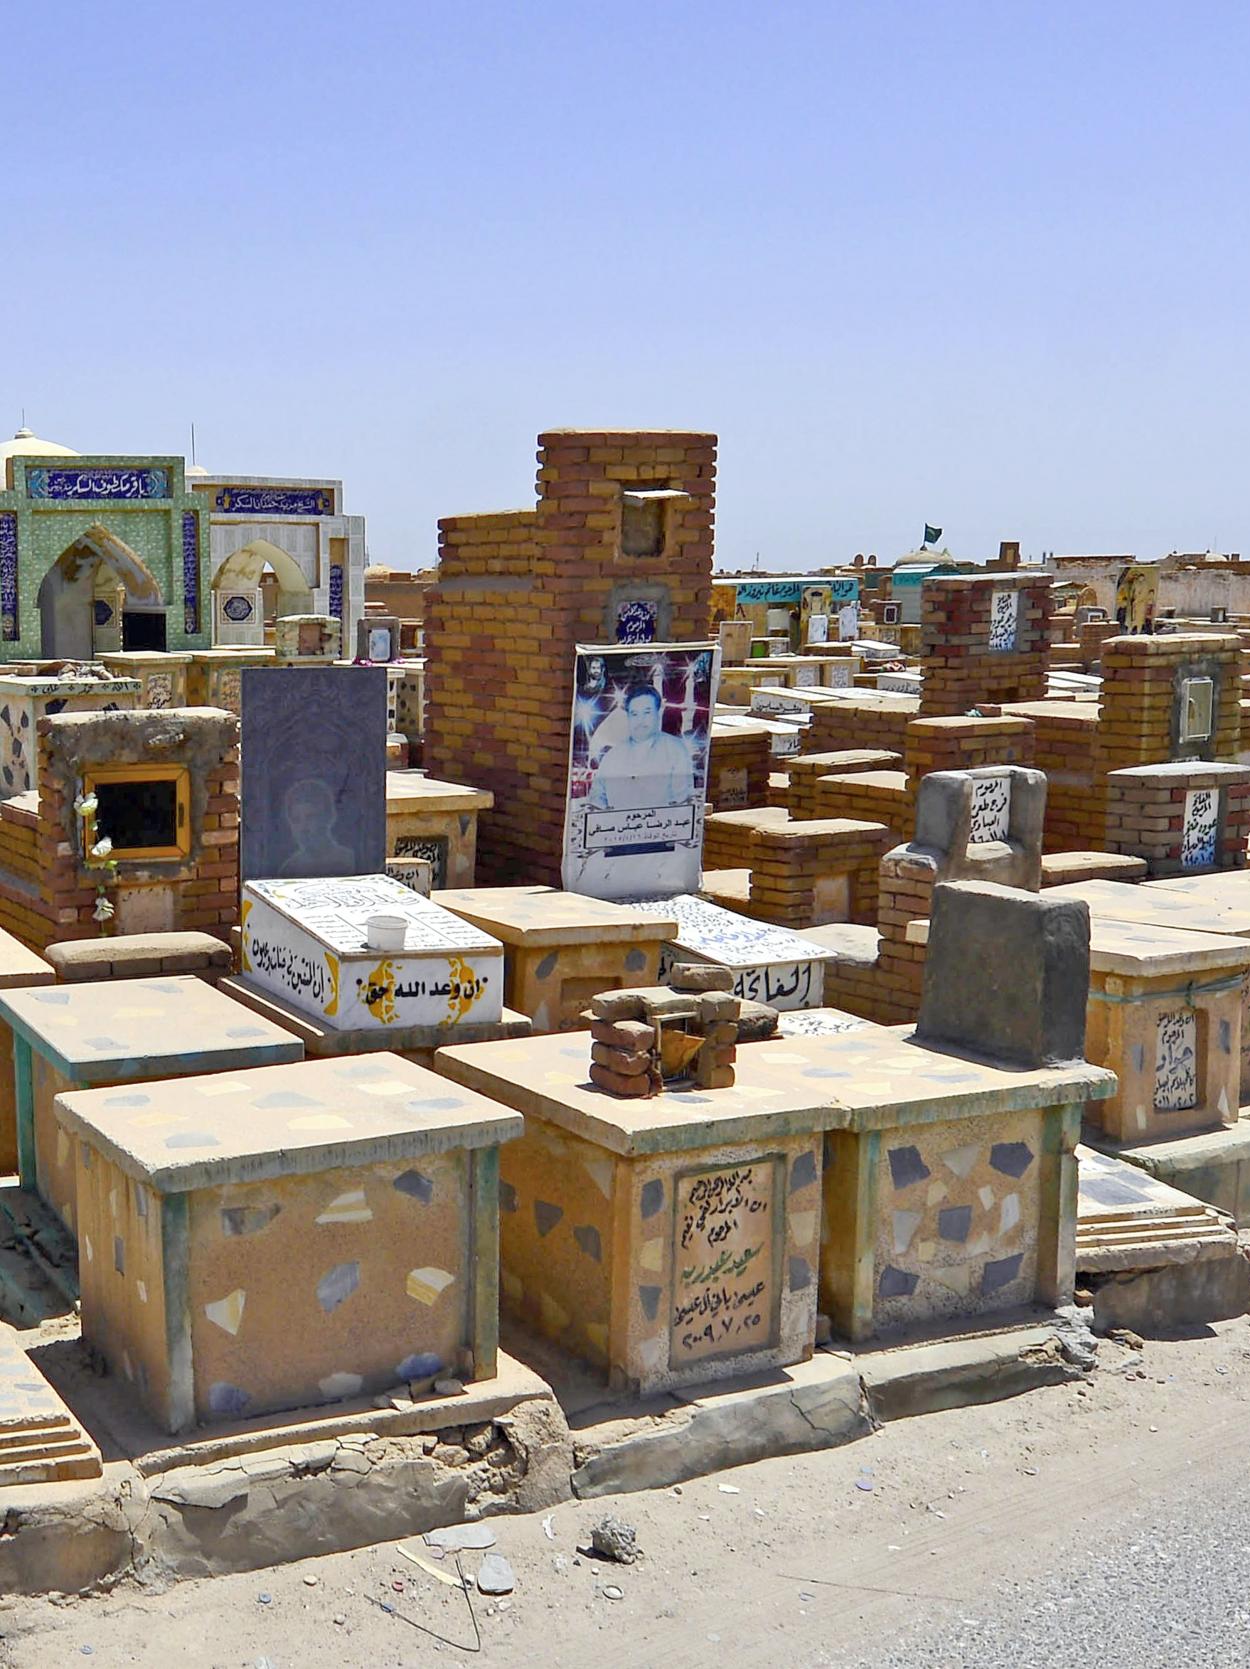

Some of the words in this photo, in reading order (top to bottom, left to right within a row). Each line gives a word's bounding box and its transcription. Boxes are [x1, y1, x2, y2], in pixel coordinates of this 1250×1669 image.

[126, 474, 147, 497] باقر
[625, 810, 656, 821] المرحوم
[646, 819, 672, 830] الرضا
[673, 819, 691, 827] عبد
[617, 822, 643, 833] عباس
[365, 980, 389, 1006] حق
[393, 981, 426, 998] الله
[429, 980, 461, 1000] وعد
[463, 979, 481, 999] ان
[708, 1220, 739, 1249] المرحوم
